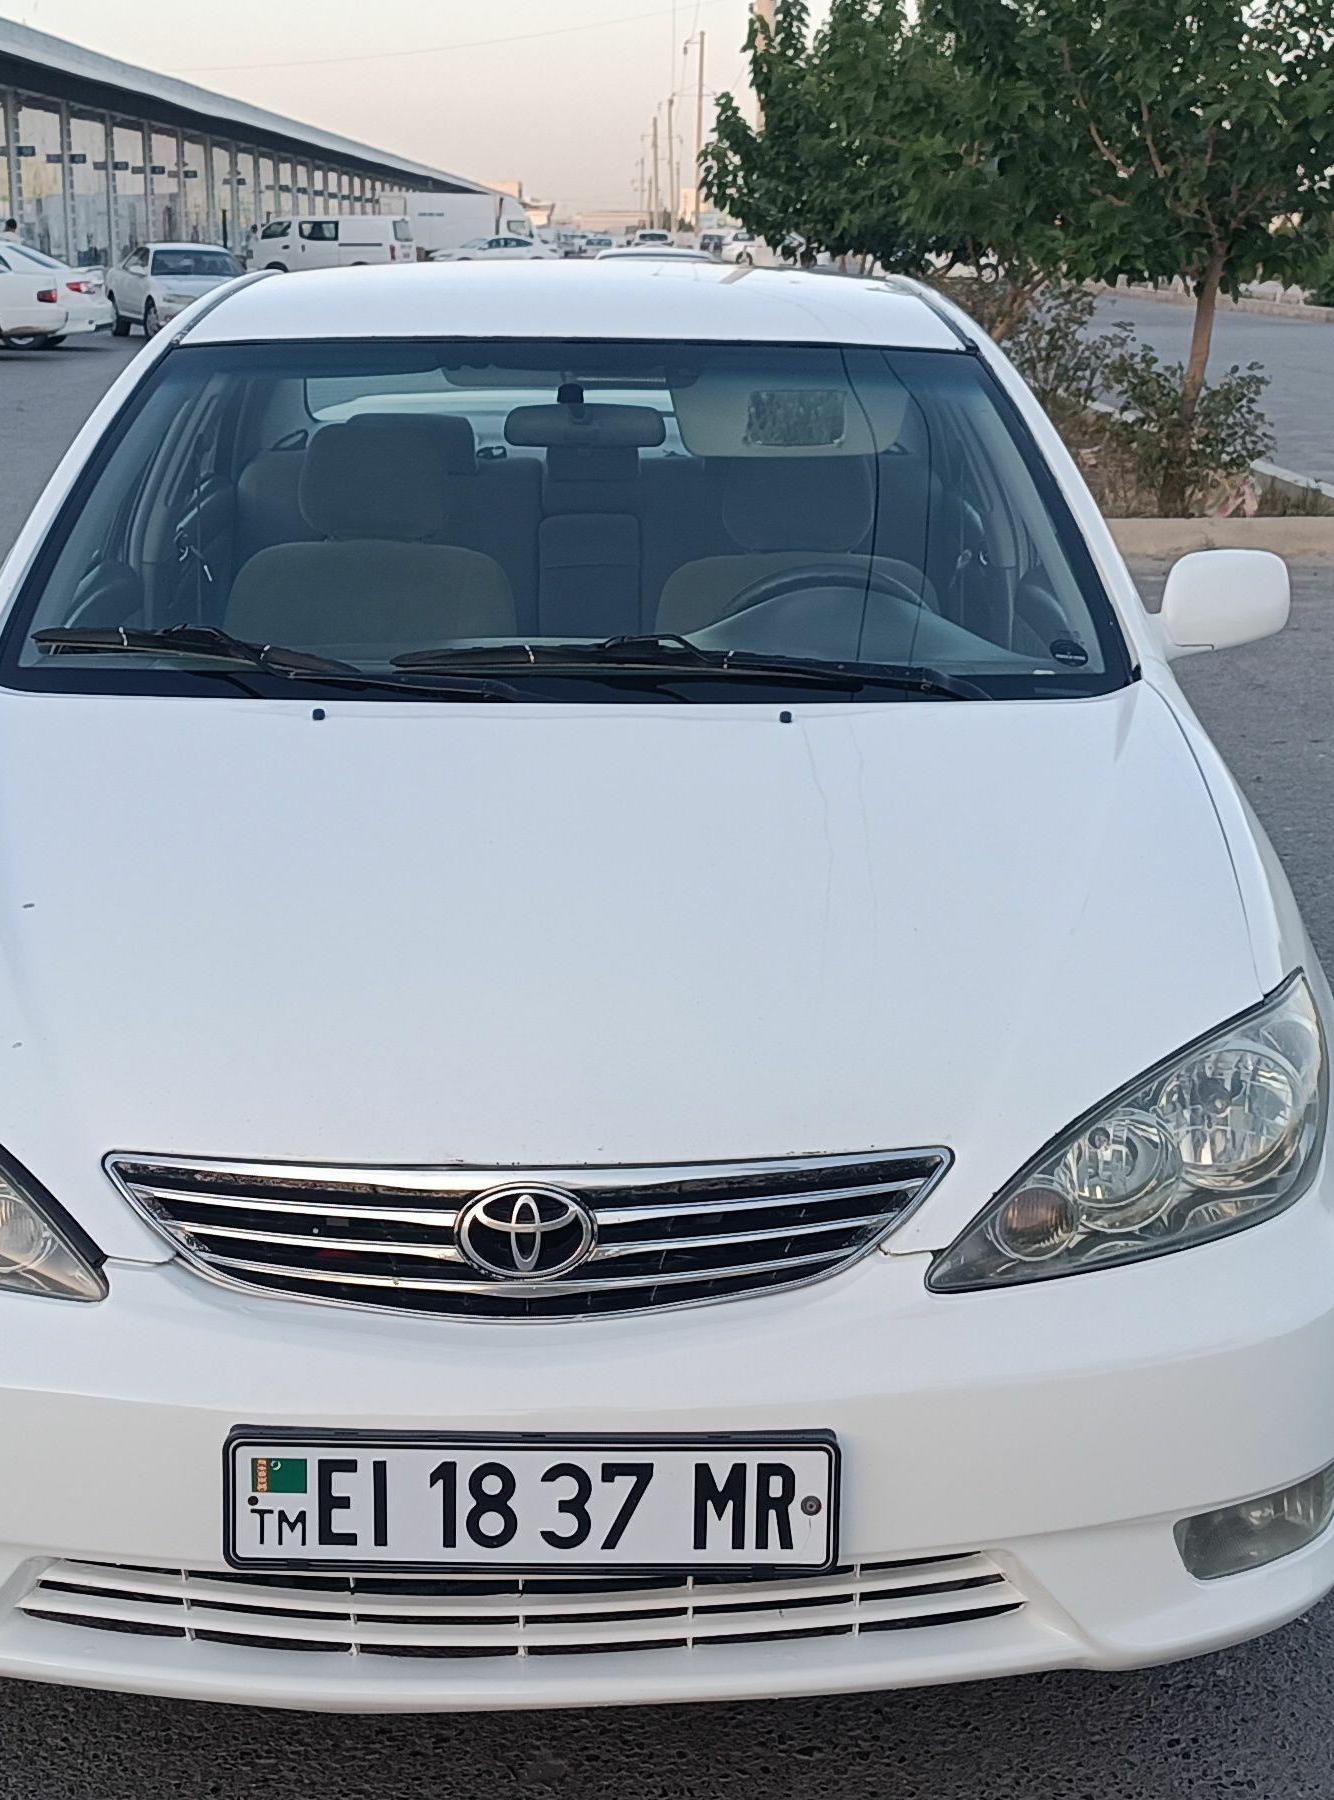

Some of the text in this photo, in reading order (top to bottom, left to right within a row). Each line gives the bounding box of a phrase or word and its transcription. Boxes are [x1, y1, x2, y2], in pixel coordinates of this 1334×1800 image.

[250, 1508, 307, 1546] TM
[318, 1459, 387, 1547] EI
[693, 1462, 795, 1550] MR
